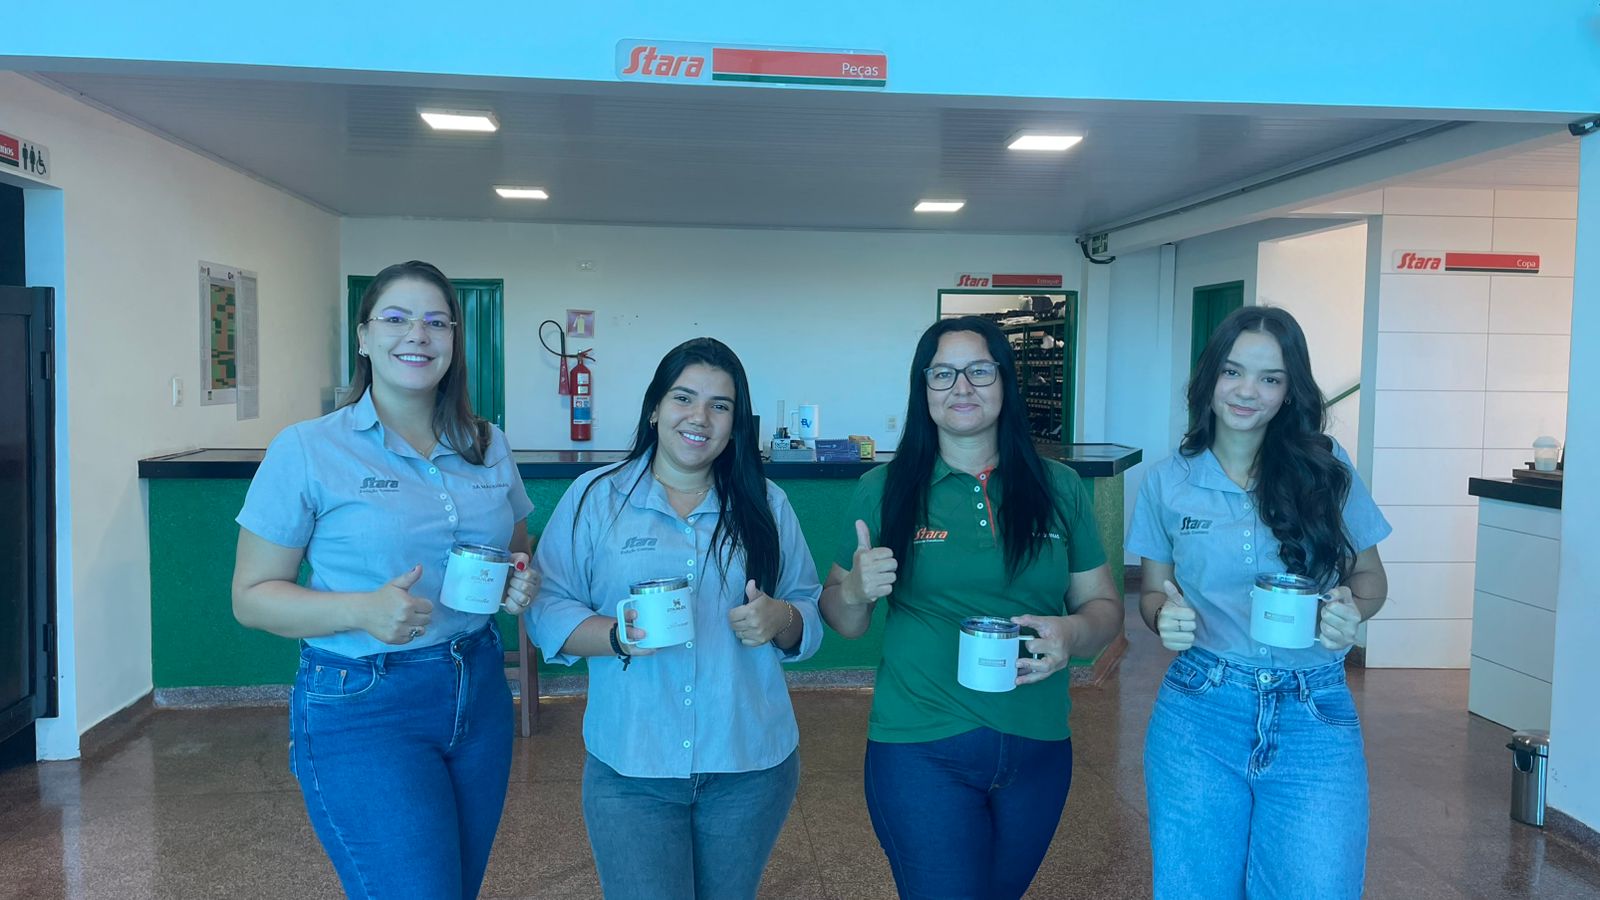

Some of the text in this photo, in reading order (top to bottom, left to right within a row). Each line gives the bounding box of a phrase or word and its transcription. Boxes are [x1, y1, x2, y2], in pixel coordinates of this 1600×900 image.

[622, 46, 705, 78] Stara
[841, 62, 879, 78] Peças
[1397, 252, 1442, 270] Stara
[1516, 259, 1536, 269] Copa
[956, 274, 989, 287] Stara
[360, 477, 399, 488] Stara
[1180, 516, 1213, 530] Stara
[913, 527, 948, 540] Stara
[621, 536, 658, 549] Stara
